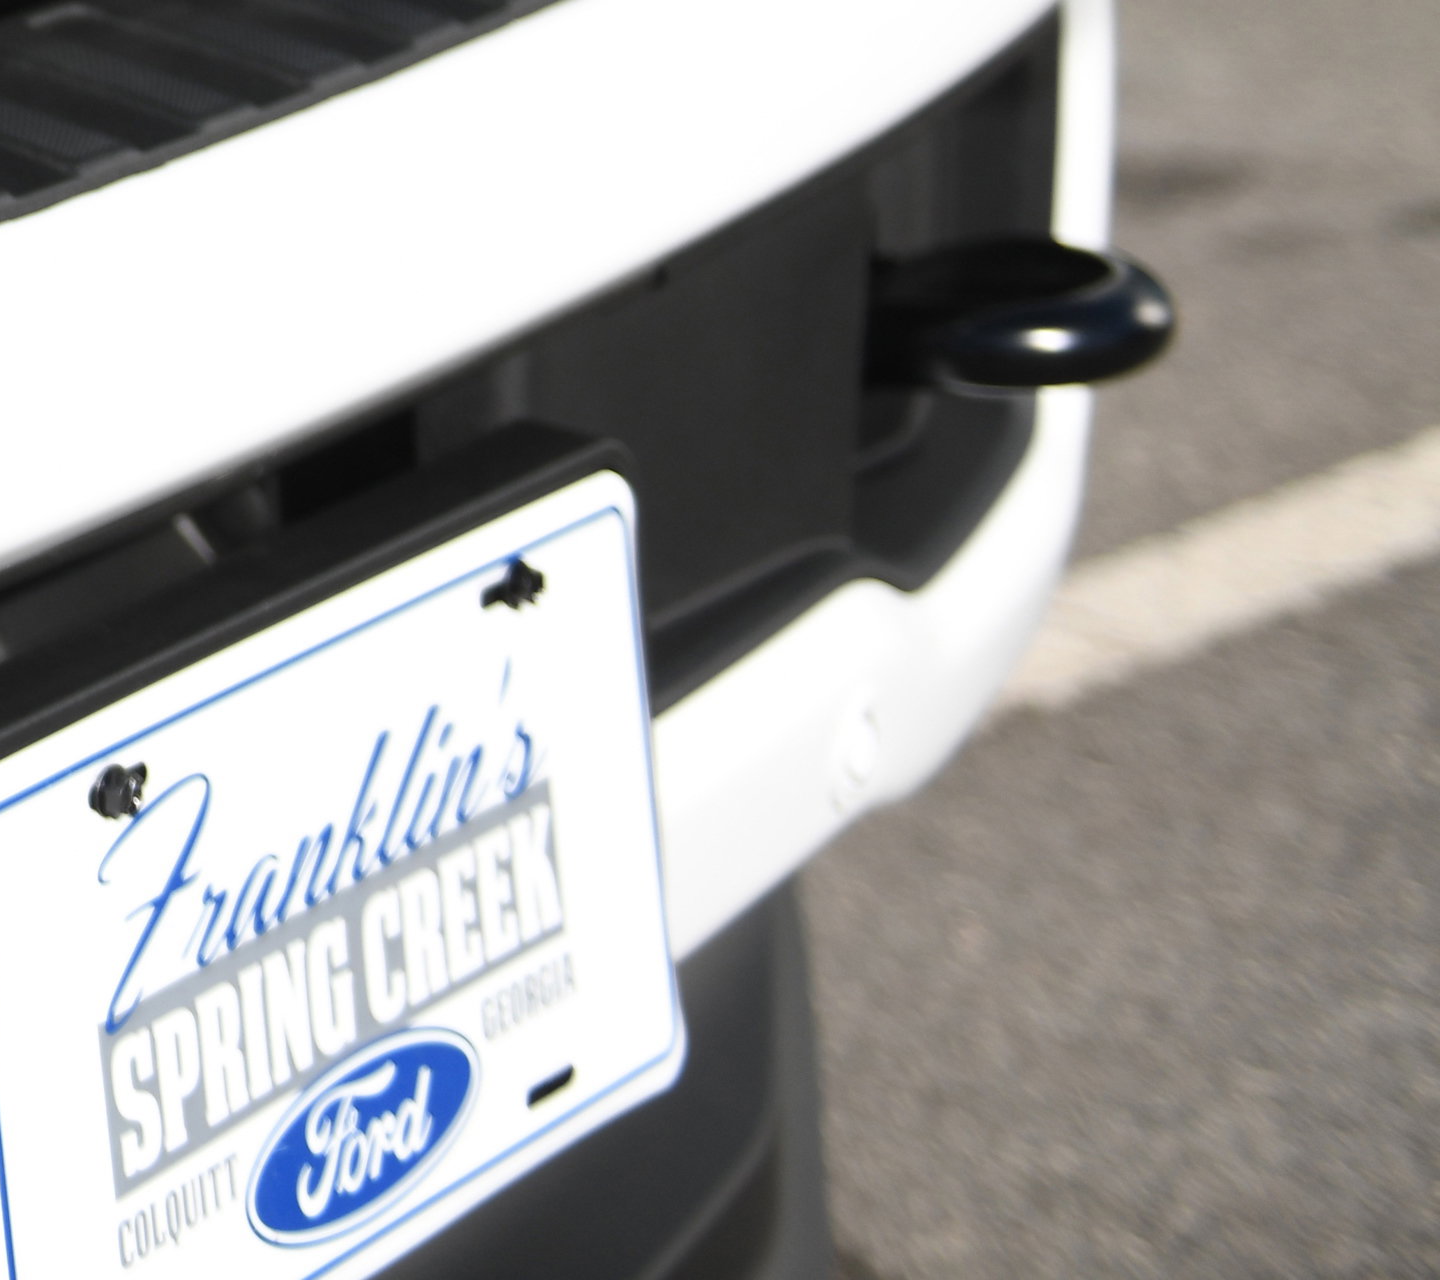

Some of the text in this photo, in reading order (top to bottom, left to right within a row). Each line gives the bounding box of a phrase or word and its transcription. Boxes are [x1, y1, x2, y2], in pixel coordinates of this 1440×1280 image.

[98, 656, 534, 1034] Franklin's
[110, 802, 564, 1179] SPRING CREEK
[481, 951, 577, 1042] GEORGIA
[117, 1152, 238, 1270] COLQUITT
[295, 1058, 433, 1220] Ford
